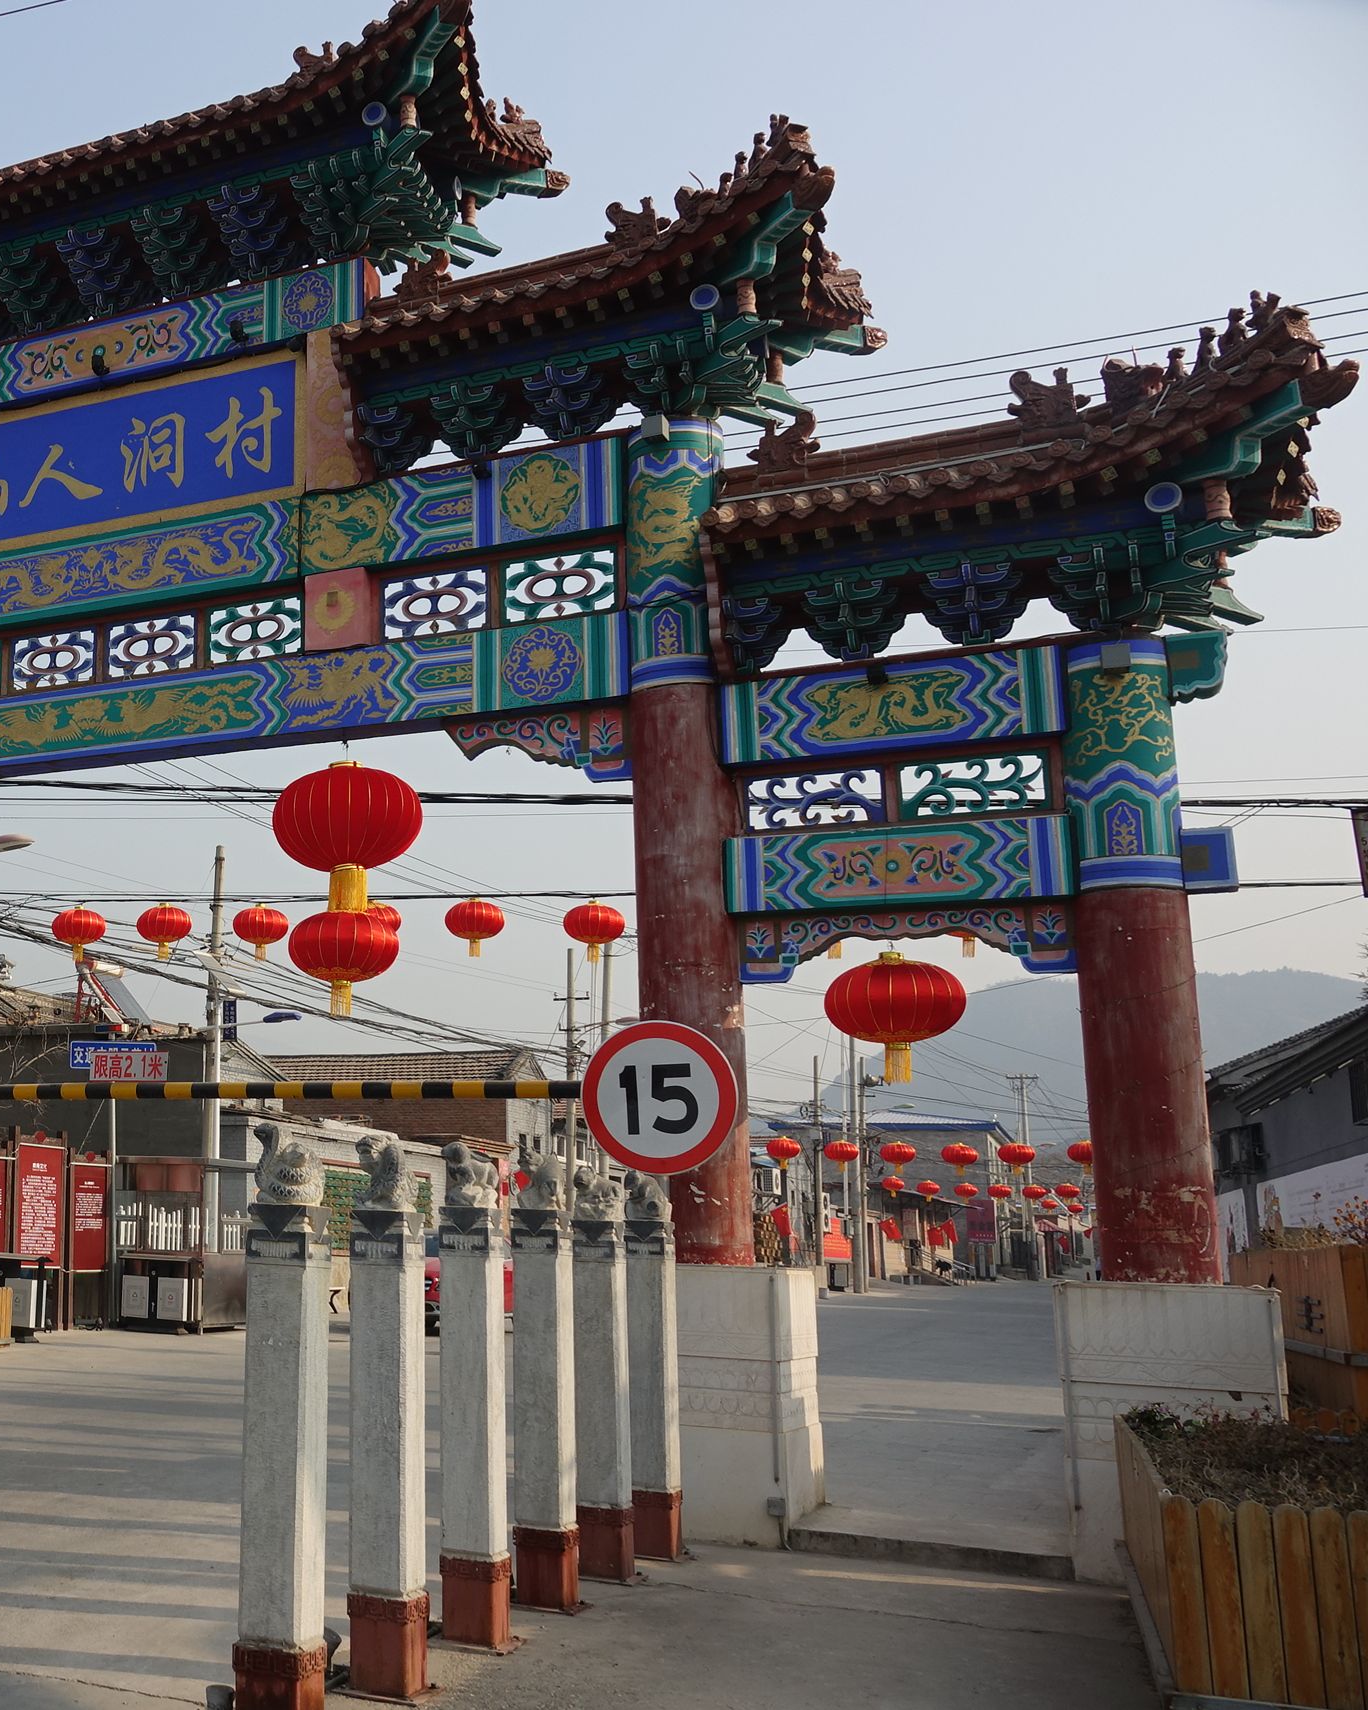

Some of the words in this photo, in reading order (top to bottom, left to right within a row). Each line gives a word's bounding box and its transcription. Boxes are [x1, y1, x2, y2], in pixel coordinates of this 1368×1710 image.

[93, 1054, 163, 1079] 限高2.1米
[618, 1062, 699, 1136] 15
